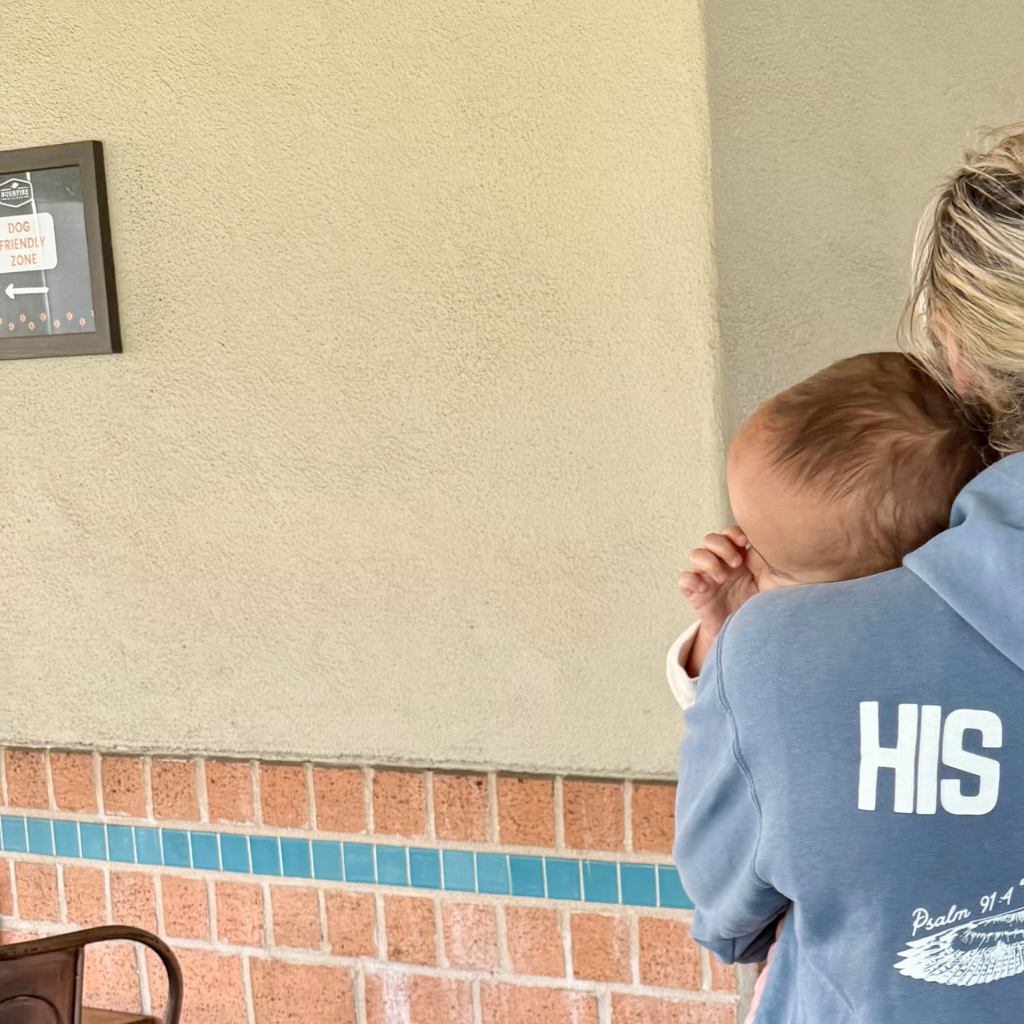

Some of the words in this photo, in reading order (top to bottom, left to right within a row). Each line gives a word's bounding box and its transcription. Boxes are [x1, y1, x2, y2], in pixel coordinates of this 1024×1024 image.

[8, 221, 31, 234] DOG
[0, 236, 45, 251] FRIENDLY
[10, 253, 37, 267] ZONE
[857, 700, 1003, 816] HIS
[911, 904, 972, 937] Psalm
